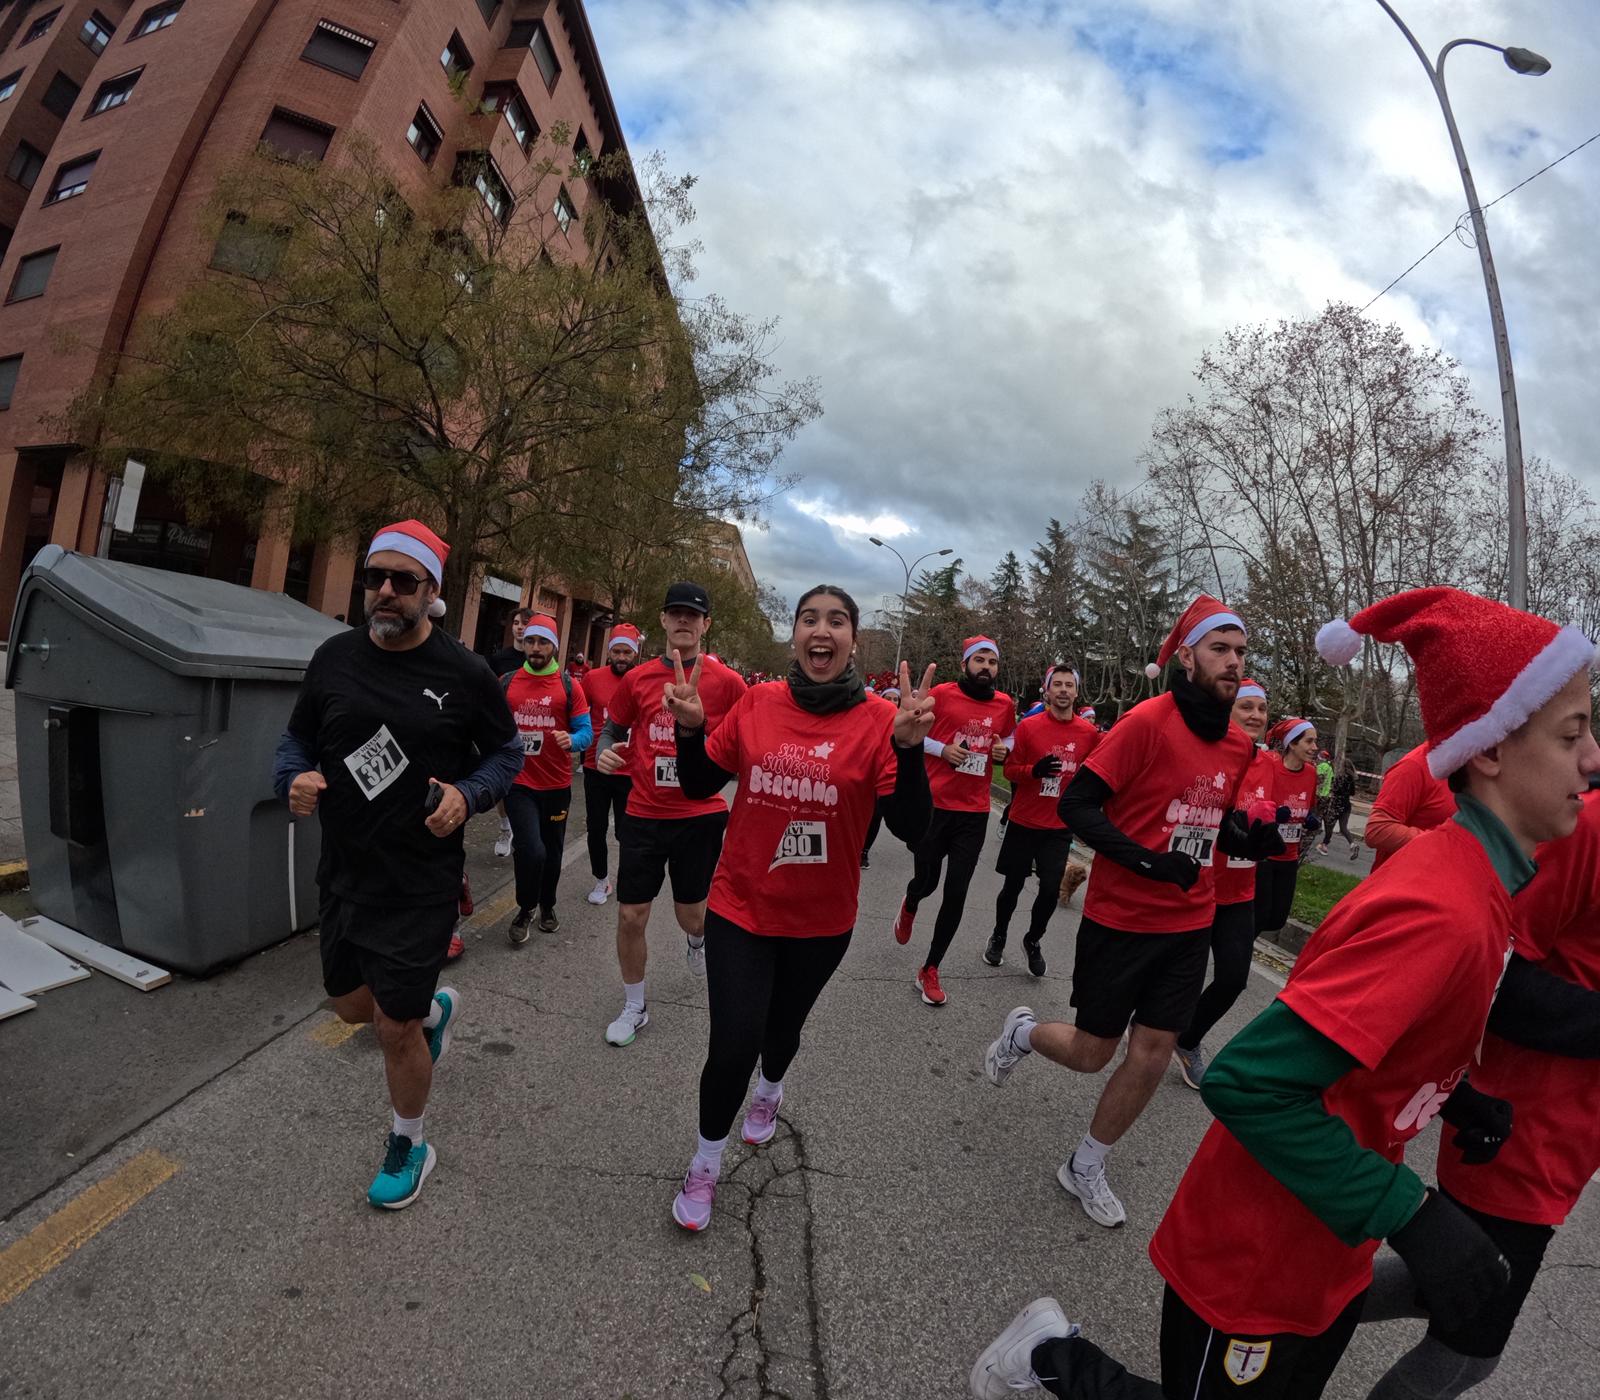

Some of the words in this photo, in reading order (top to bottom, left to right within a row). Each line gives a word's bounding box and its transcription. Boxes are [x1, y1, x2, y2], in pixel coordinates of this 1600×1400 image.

[361, 742, 382, 760] XLVI
[778, 743, 805, 760] SAN
[361, 747, 396, 786] 327
[762, 752, 830, 782] SILVESTRE
[749, 765, 838, 807] BERCIANA
